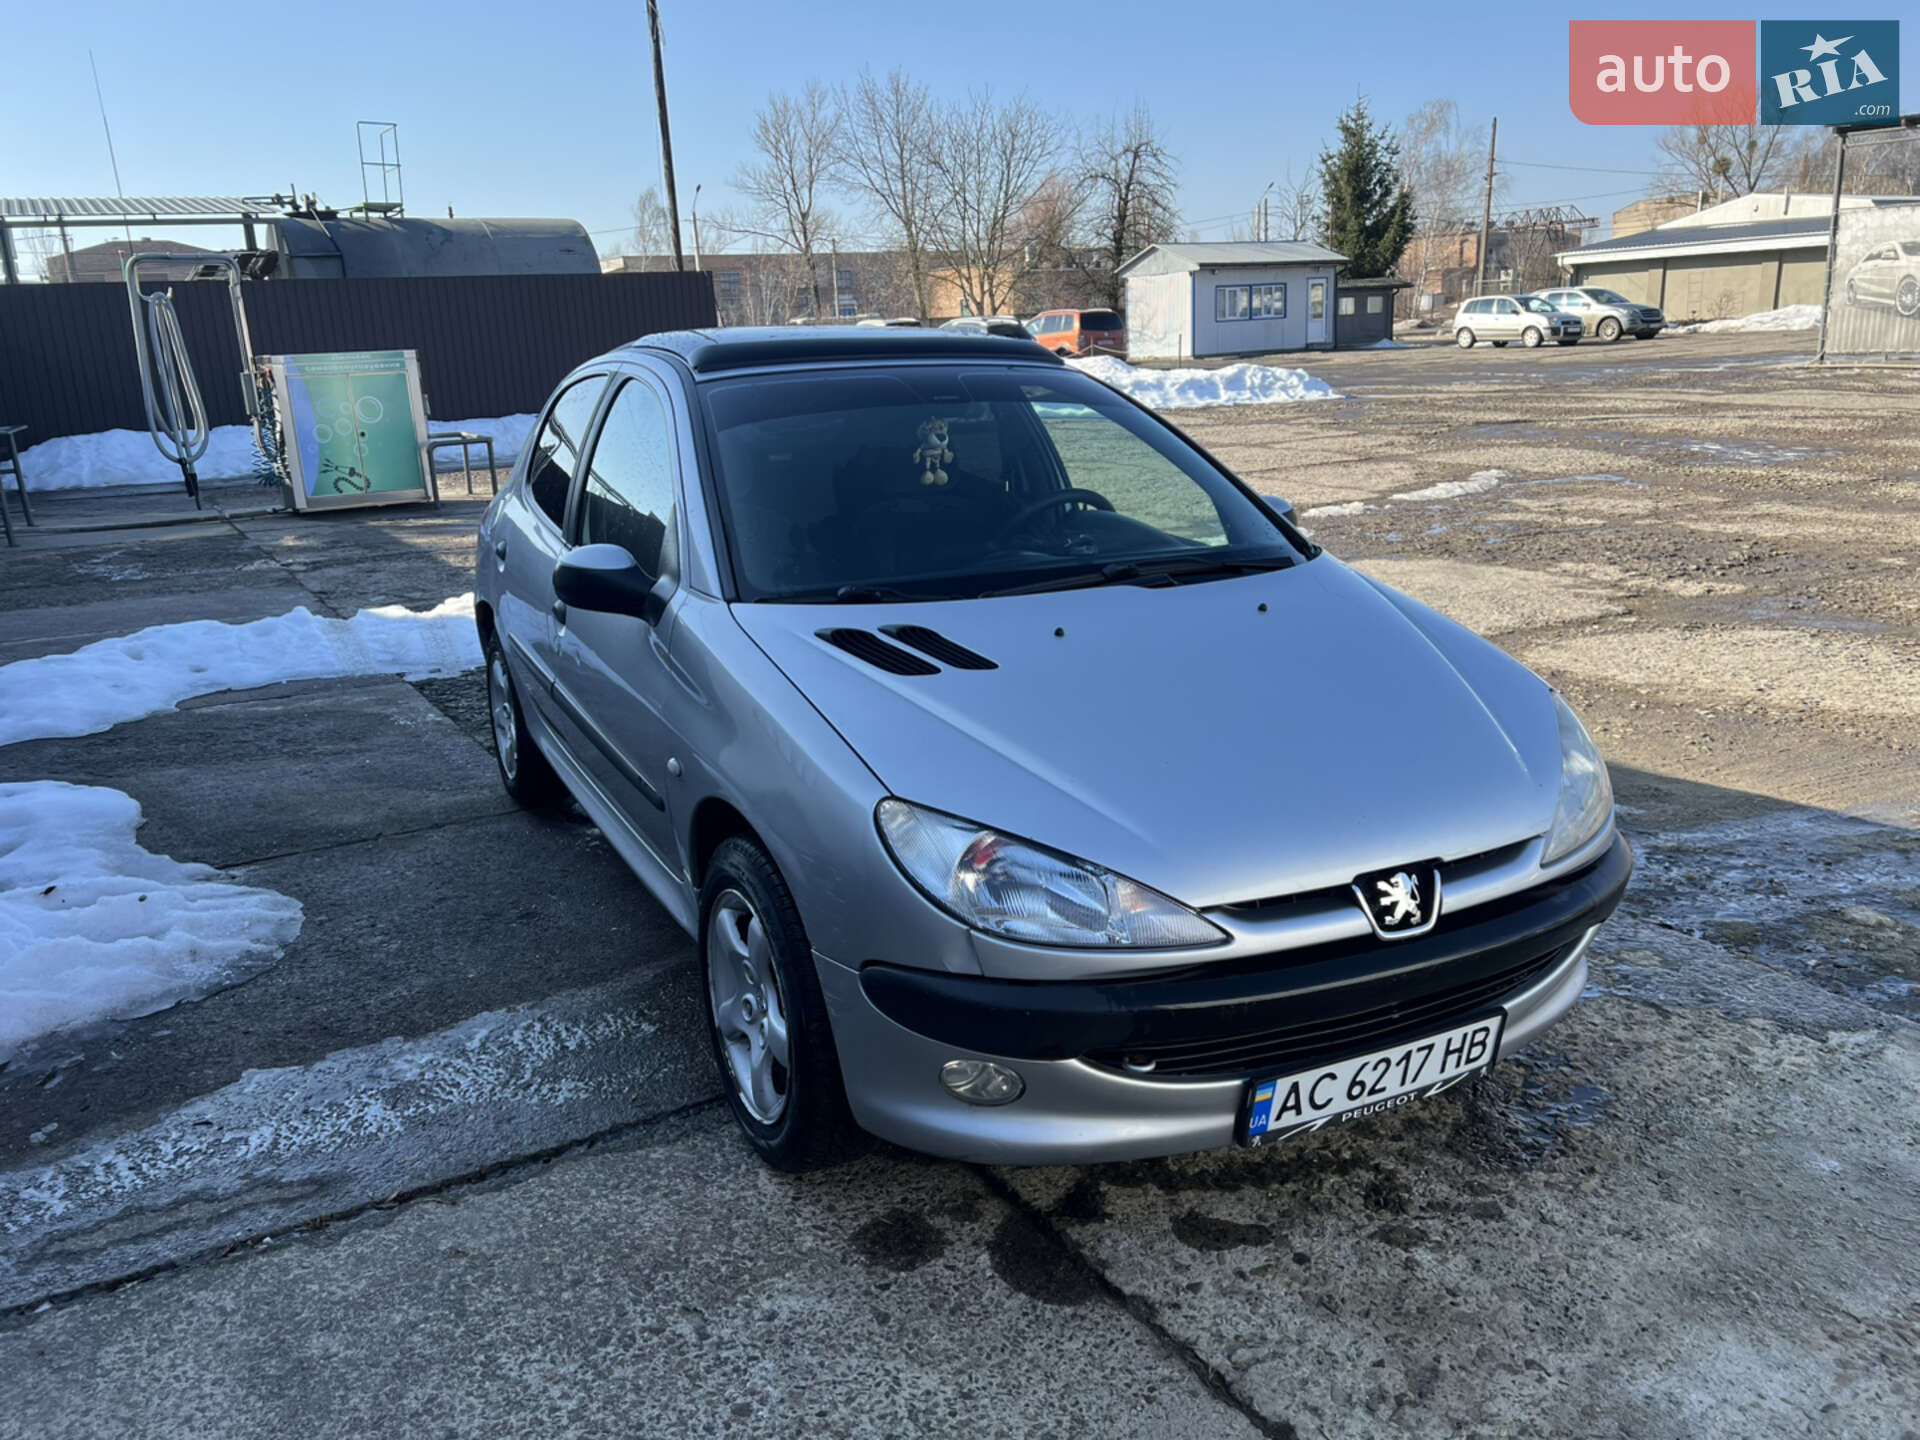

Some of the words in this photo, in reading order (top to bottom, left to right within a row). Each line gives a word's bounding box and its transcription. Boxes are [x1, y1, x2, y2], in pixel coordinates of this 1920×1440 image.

[1275, 1072, 1337, 1121] AC
[1346, 1043, 1436, 1100] 6217
[1439, 1026, 1491, 1074] HB
[1249, 1114, 1267, 1128] UA
[1341, 1091, 1419, 1122] PEUGEOT
